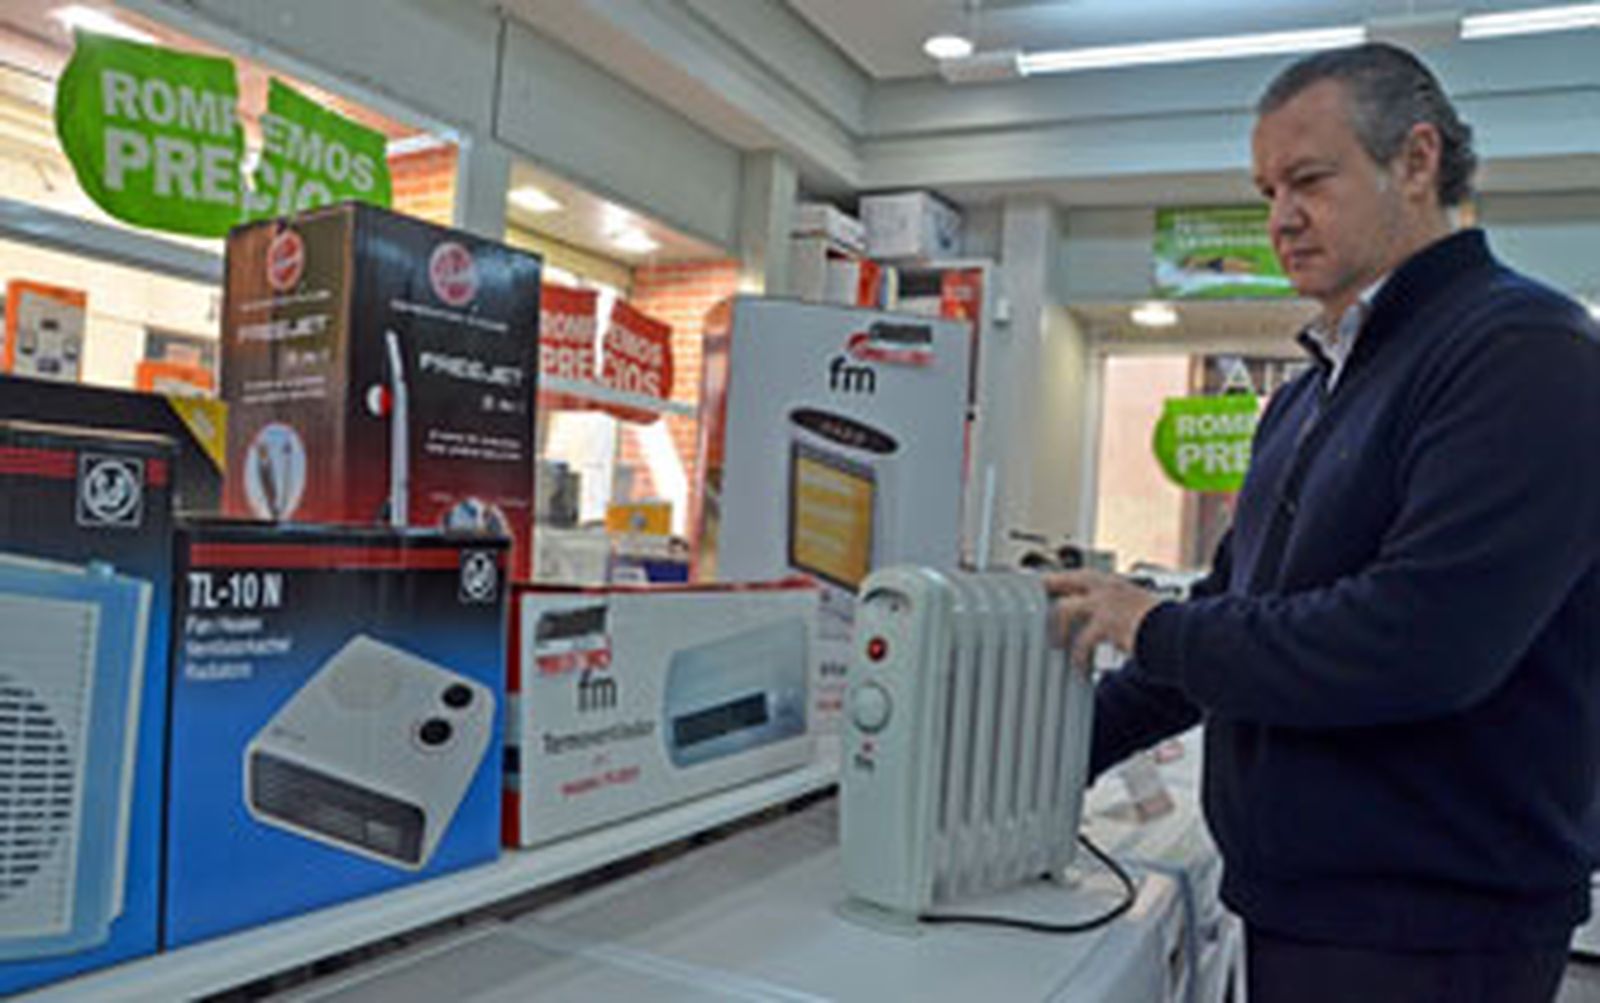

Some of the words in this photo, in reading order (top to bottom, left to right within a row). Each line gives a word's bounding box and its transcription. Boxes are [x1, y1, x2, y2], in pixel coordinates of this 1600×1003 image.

[830, 356, 876, 394] fm
[188, 572, 259, 609] TL-10
[262, 573, 283, 608] N
[577, 667, 618, 713] fm
